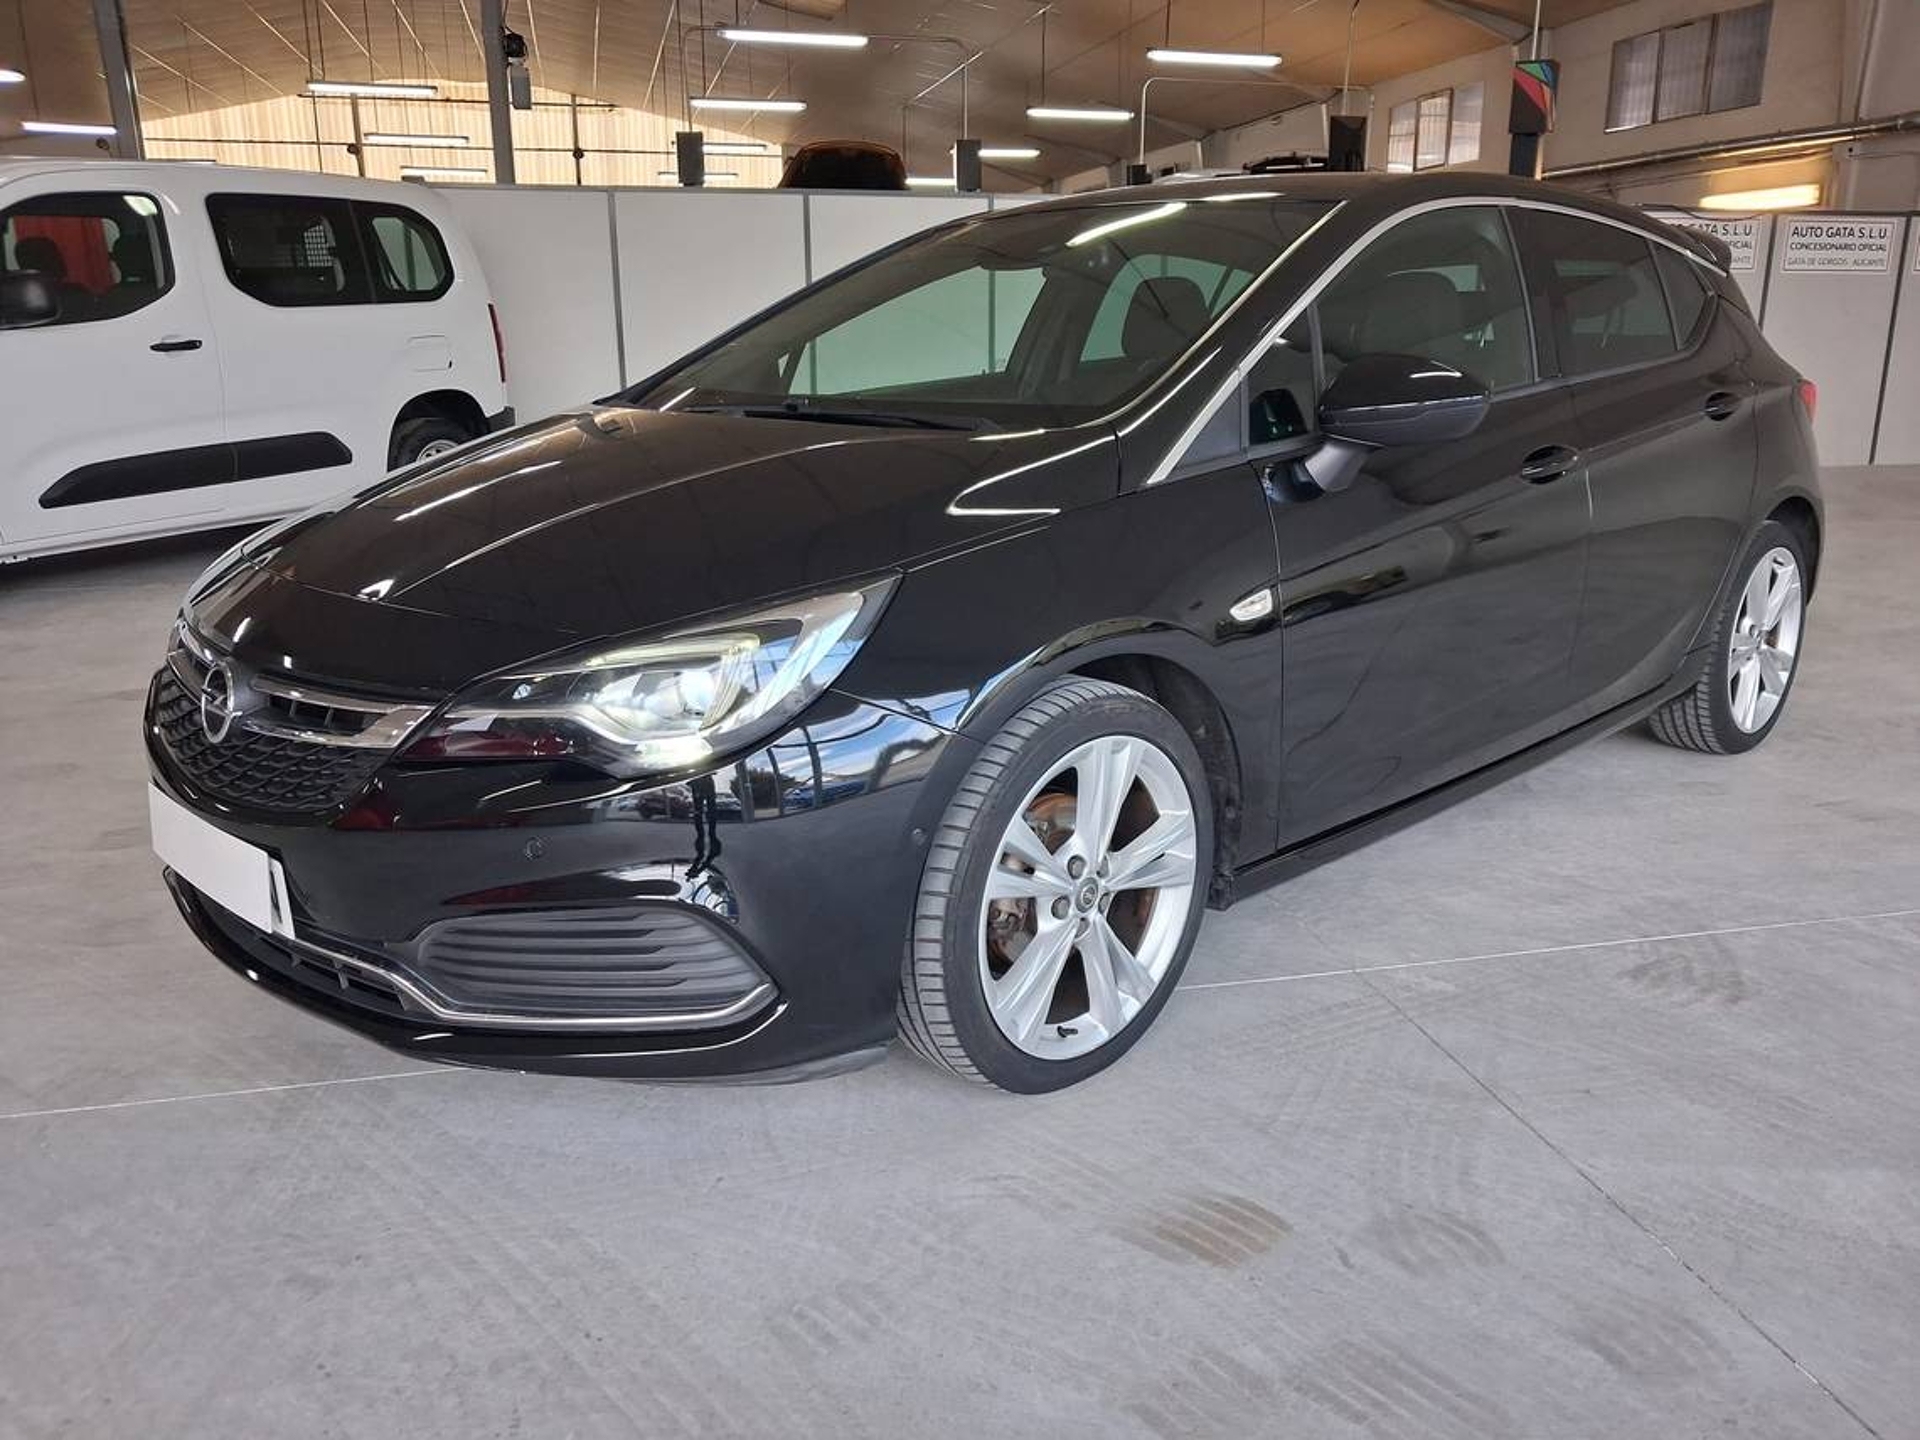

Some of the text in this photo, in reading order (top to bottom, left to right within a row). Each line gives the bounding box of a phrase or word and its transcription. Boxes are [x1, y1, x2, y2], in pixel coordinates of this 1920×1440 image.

[1792, 226, 1823, 238] AUTO
[1825, 227, 1855, 238] GATA
[1790, 242, 1887, 252] CONCESIONARIO OFICIAL
